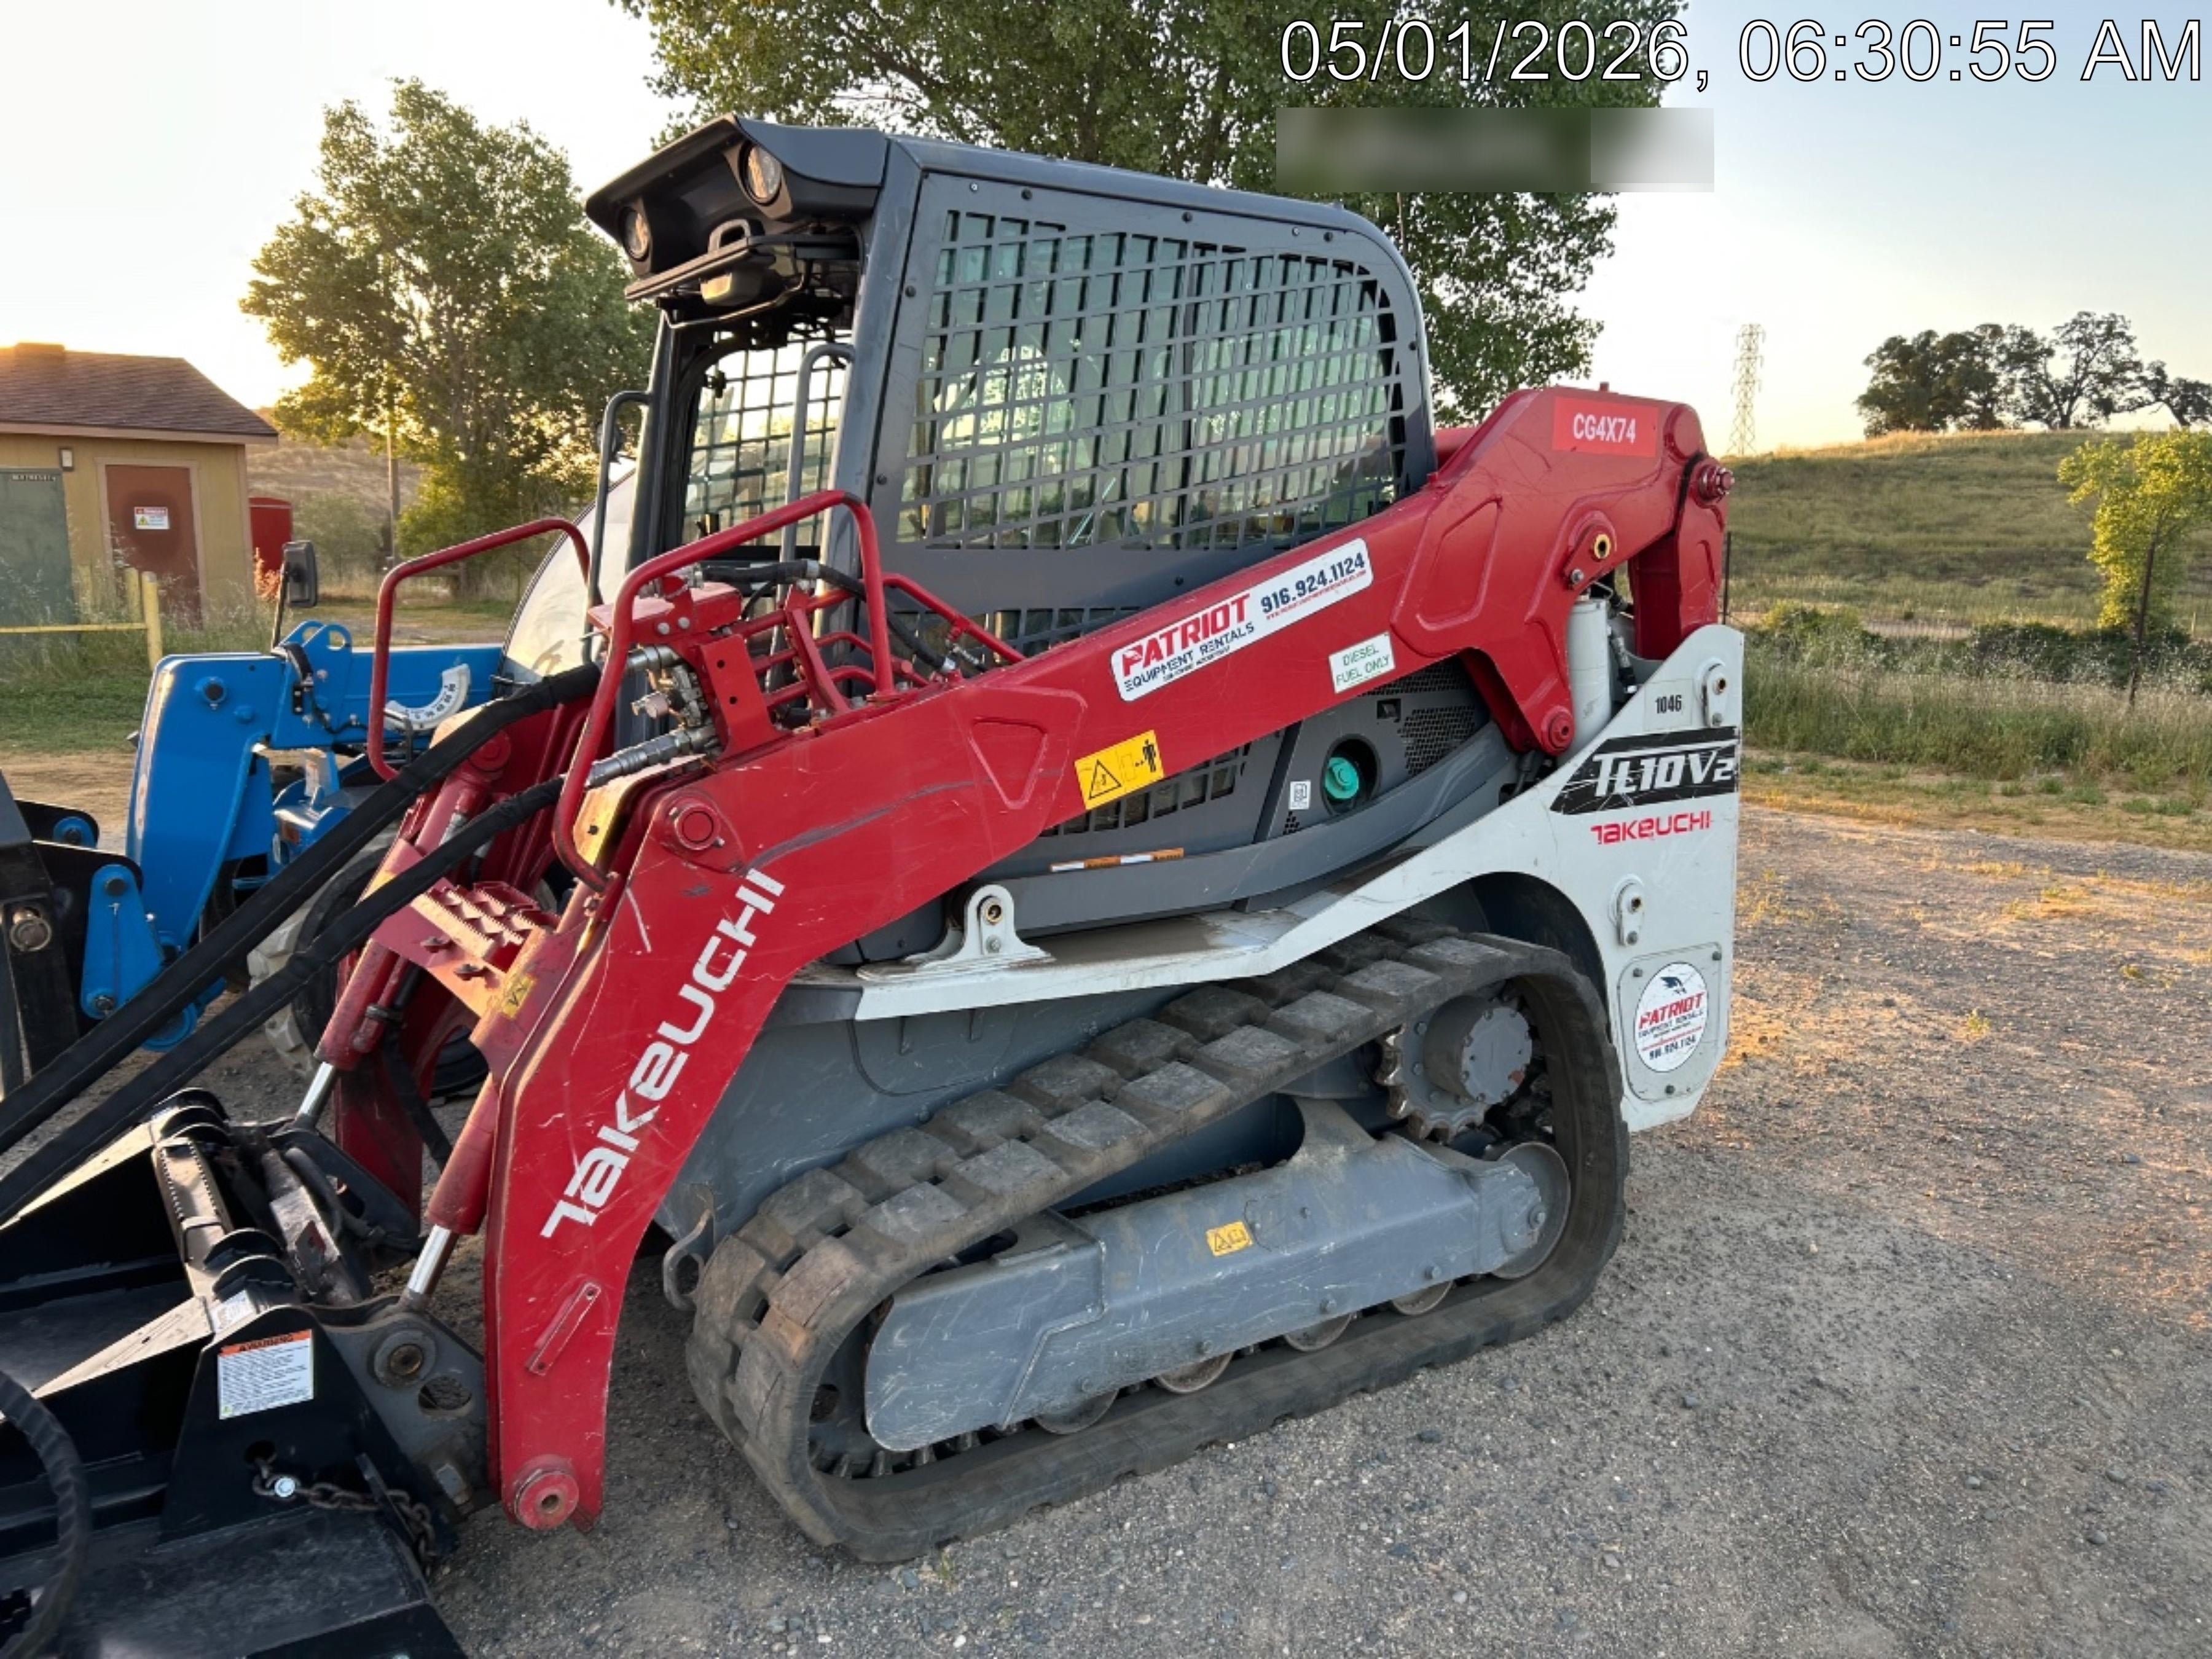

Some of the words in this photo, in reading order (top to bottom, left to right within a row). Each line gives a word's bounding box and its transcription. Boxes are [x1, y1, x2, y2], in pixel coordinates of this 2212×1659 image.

[1573, 412, 1636, 445] CG4X74
[1261, 552, 1365, 613] 916.924.1124
[1122, 594, 1250, 677] PATRIOT
[1124, 650, 1194, 692] EQUIPMENT
[1199, 621, 1255, 656] RENTALS
[1336, 668, 1363, 686] FUEL
[1366, 654, 1390, 673] ONLY
[1343, 643, 1379, 666] DIESEL
[1655, 694, 1682, 714] 1046
[1638, 990, 1706, 1029] PATRIOT
